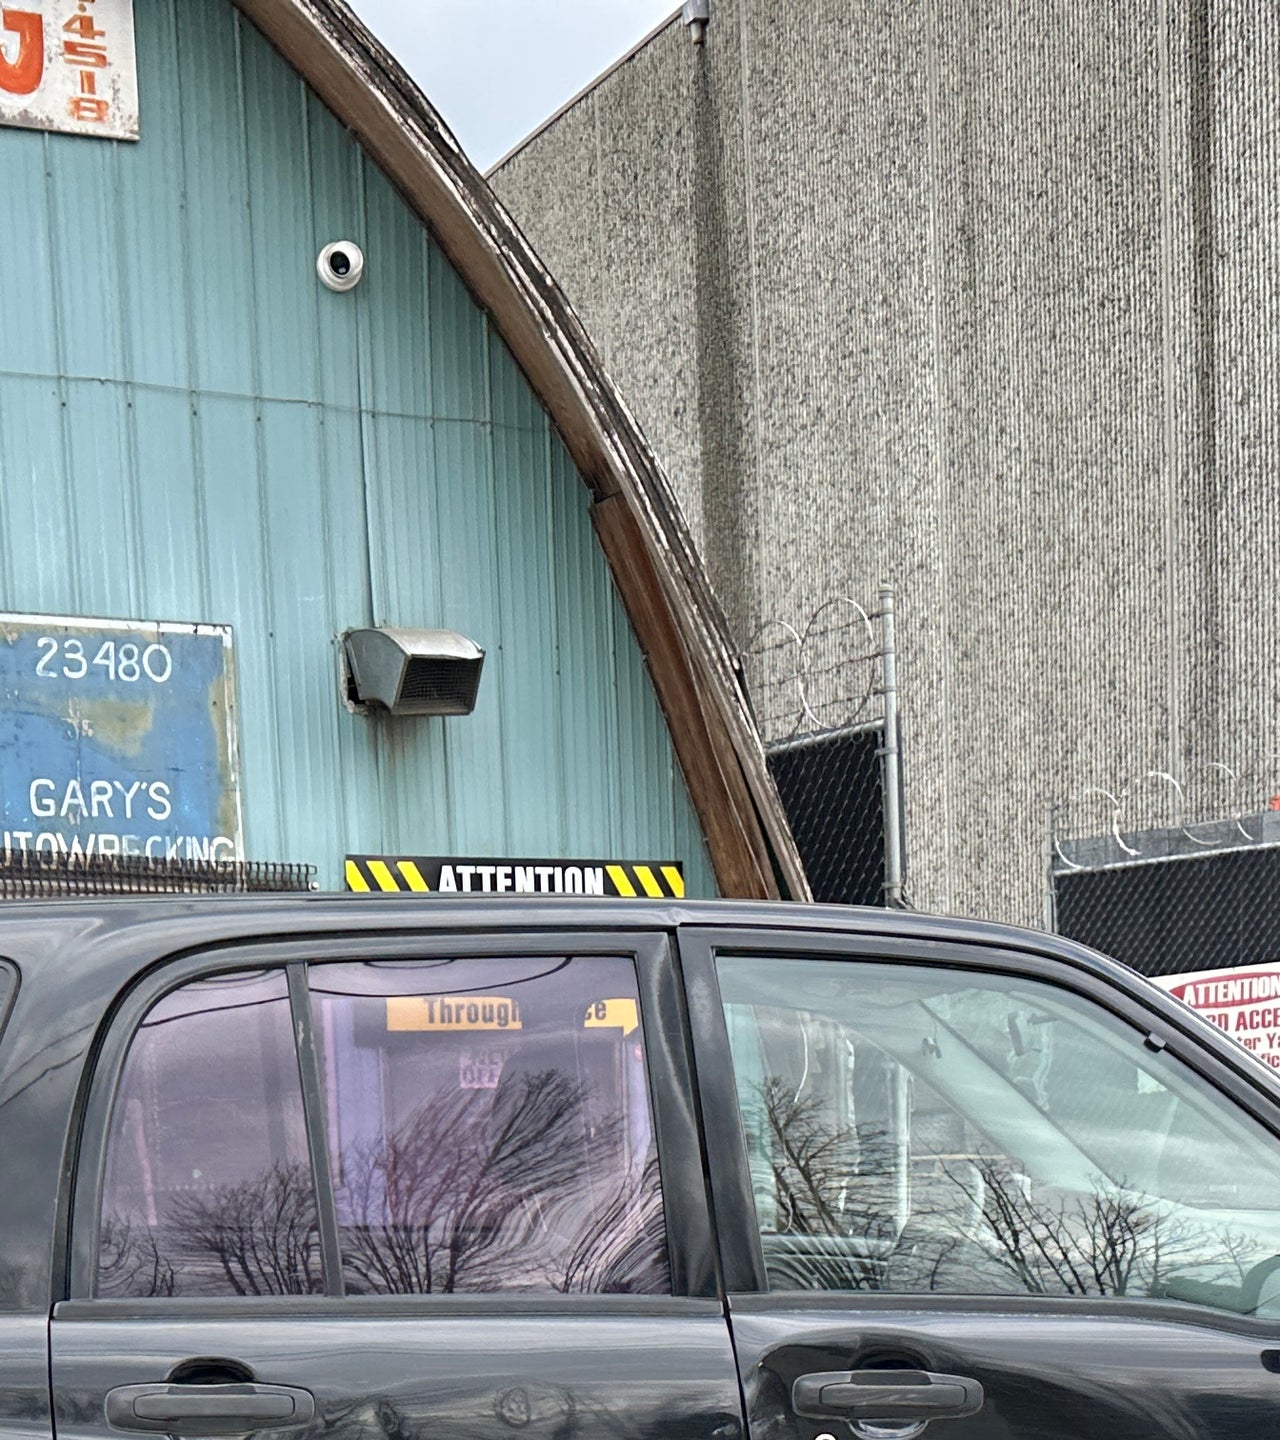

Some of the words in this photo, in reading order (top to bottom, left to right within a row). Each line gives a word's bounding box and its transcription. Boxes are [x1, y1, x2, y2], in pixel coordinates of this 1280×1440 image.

[36, 637, 172, 683] 23480
[30, 778, 171, 820] GARY'S
[439, 865, 605, 895] ATTENTION
